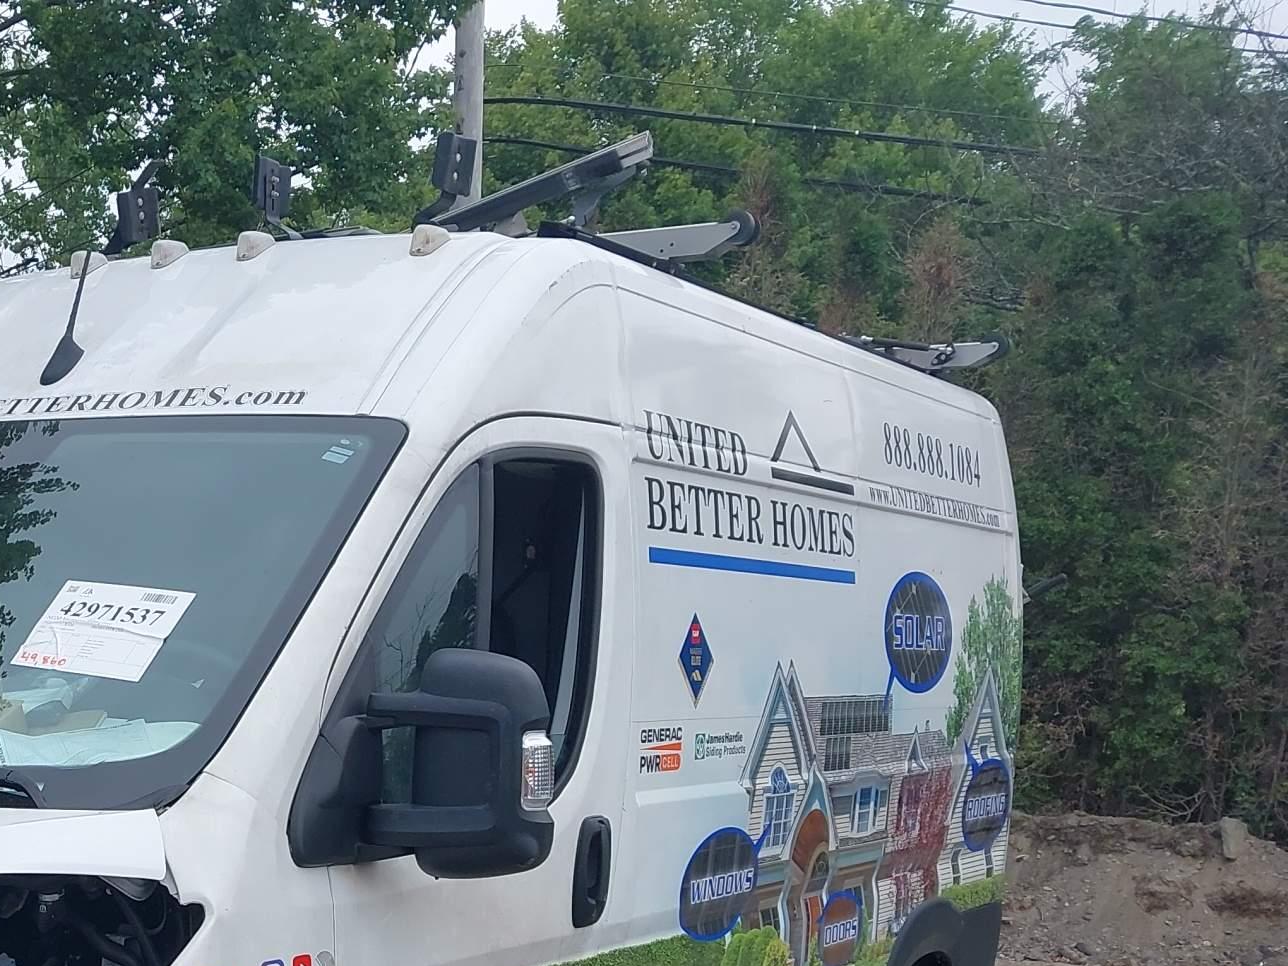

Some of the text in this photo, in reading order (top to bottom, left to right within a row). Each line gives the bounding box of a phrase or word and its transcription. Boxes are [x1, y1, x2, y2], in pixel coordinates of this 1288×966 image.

[643, 409, 748, 477] UNITED
[883, 422, 982, 488] 888.888.1084
[644, 476, 856, 557] BETTER HOMES
[869, 486, 1001, 528] www.UNITEDBETTERHOMES.com
[60, 600, 167, 627] 42971537
[893, 613, 946, 651] SOLAR
[640, 727, 683, 744] GENERAC
[690, 867, 754, 904] WINDOWS
[823, 917, 858, 948] DOORS
